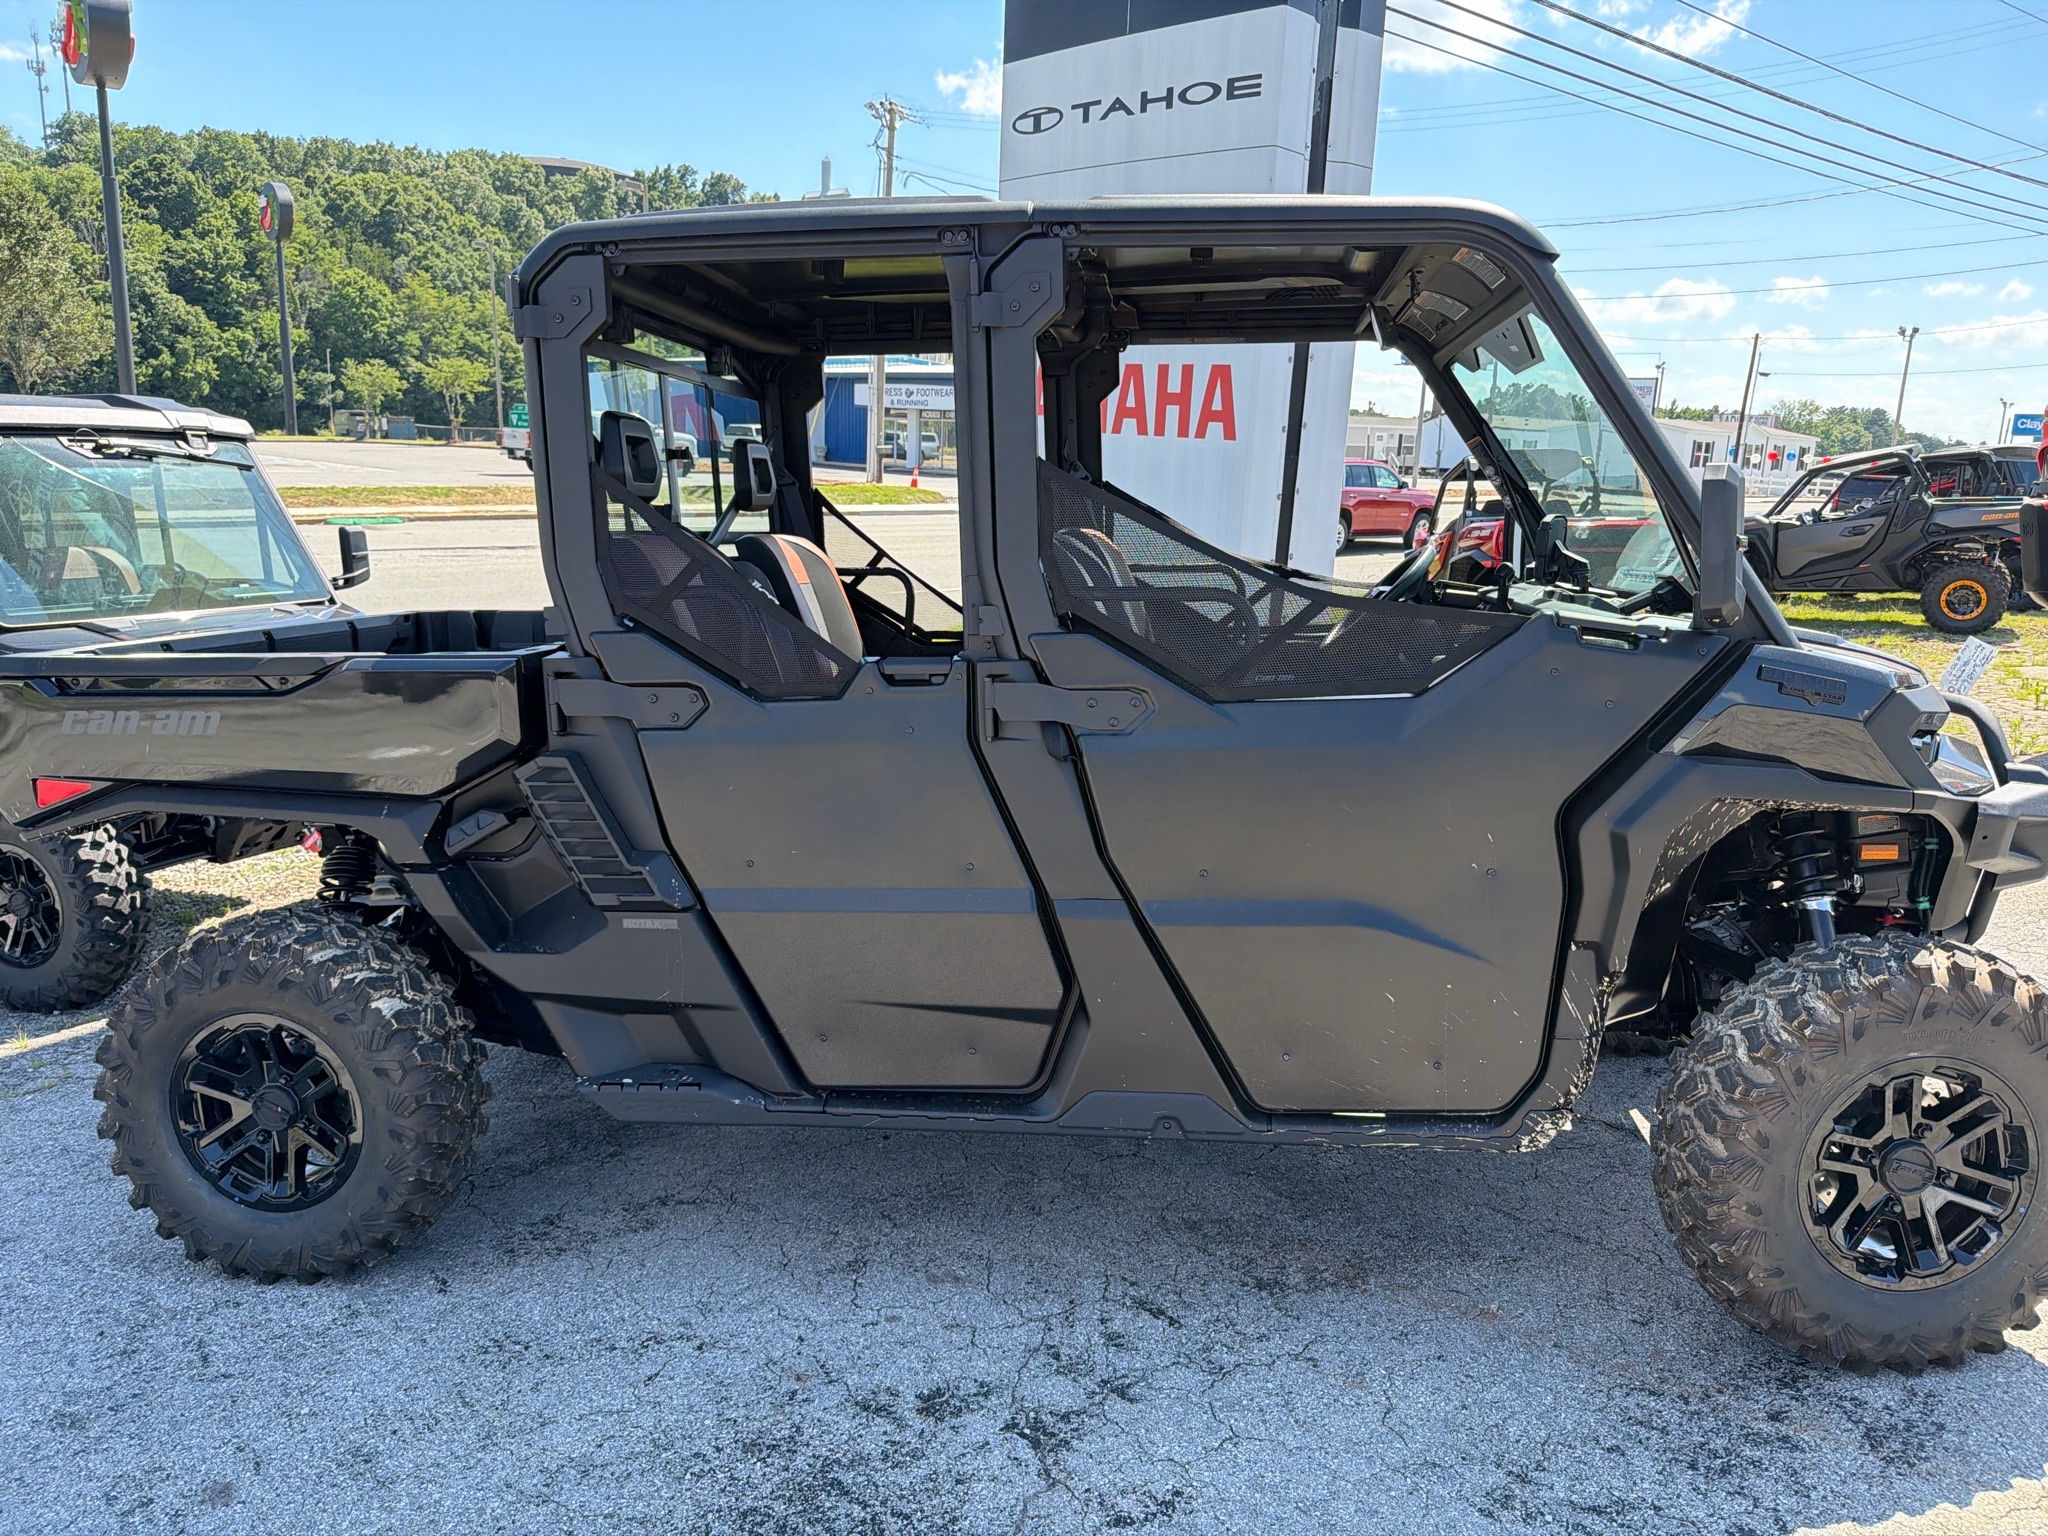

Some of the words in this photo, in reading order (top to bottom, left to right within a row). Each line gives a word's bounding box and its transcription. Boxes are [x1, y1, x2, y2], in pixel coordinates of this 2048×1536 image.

[1071, 73, 1263, 124] TAHOE
[885, 387, 903, 397] RESS
[916, 387, 953, 398] FOOTWEAR
[1634, 385, 1654, 393] PRESS
[897, 399, 928, 407] RUNNING
[2017, 418, 2044, 431] Clay
[1763, 668, 1846, 692] DEFENDER
[1785, 685, 1805, 694] LONE
[1823, 692, 1843, 701] STAR
[61, 710, 222, 736] can-am
